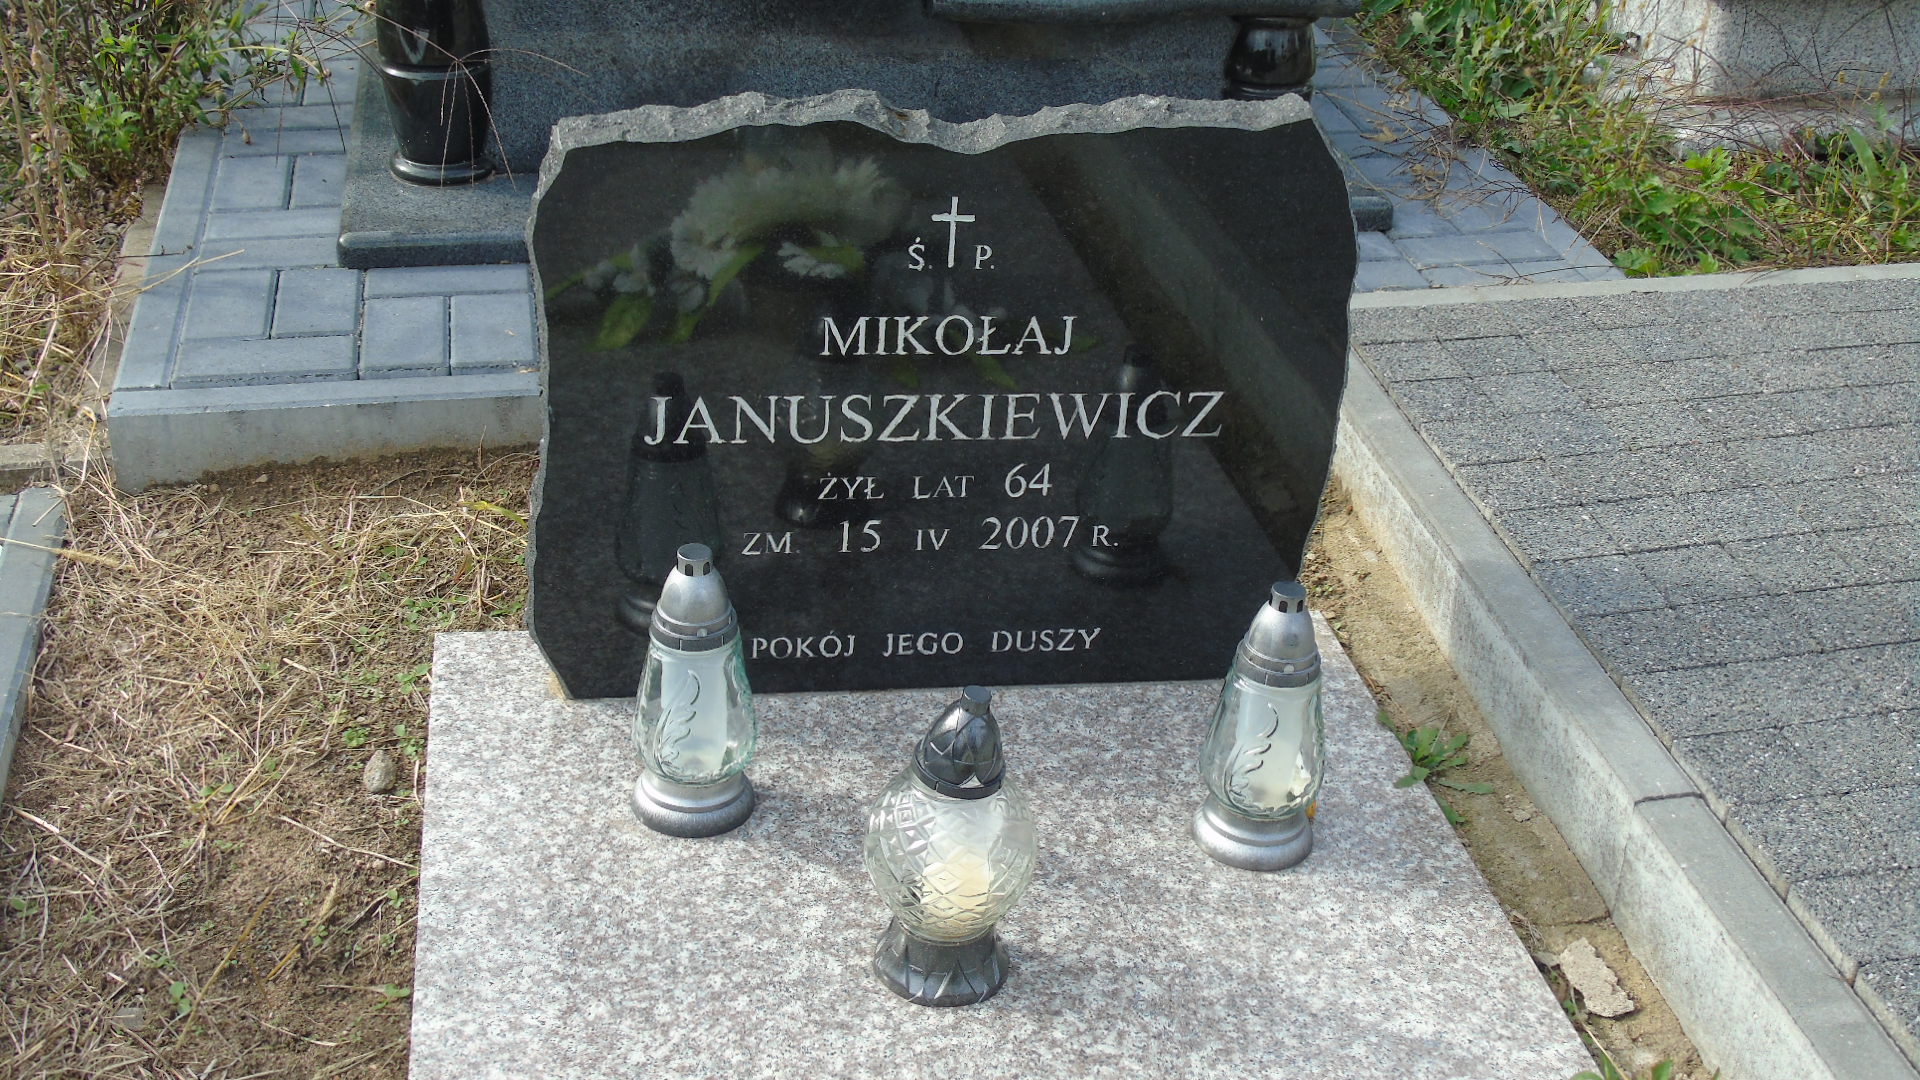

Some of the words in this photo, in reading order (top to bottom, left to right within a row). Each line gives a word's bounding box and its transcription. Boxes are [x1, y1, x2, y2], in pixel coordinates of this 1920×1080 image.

[973, 244, 996, 270] P.
[820, 314, 1077, 356] MIKOŁAJ
[643, 390, 1225, 445] JANUSZKIEWICZ
[817, 472, 885, 500] ŻYŁ
[912, 475, 975, 500] LAT
[1004, 463, 1053, 498] 64
[838, 519, 882, 553] 15
[914, 528, 950, 551] IV
[978, 515, 1080, 550] 2007
[1091, 524, 1119, 547] R.
[751, 631, 856, 659] POKÓJ
[883, 632, 964, 657] JEGO
[991, 627, 1102, 653] DUSZY
